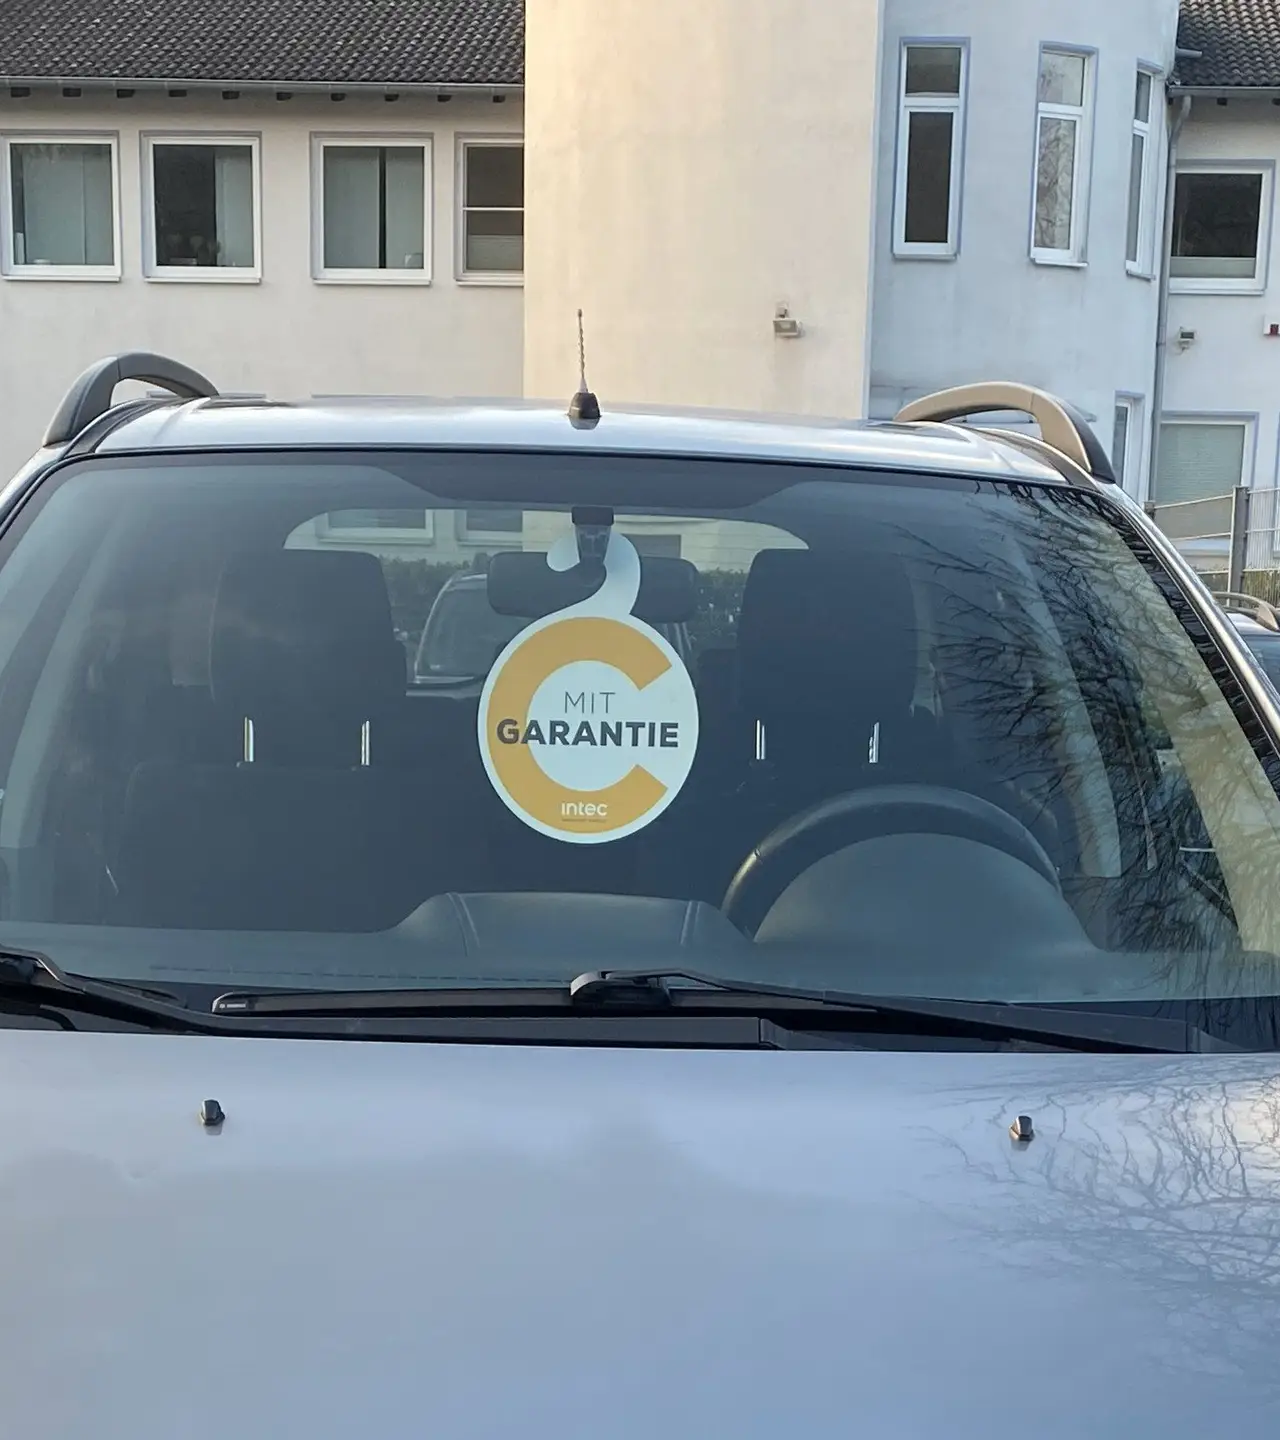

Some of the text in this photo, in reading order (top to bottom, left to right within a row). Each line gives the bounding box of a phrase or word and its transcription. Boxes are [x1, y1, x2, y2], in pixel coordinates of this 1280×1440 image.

[564, 691, 616, 714] MIT
[496, 718, 680, 748] GARANTIE
[561, 801, 608, 816] intec
